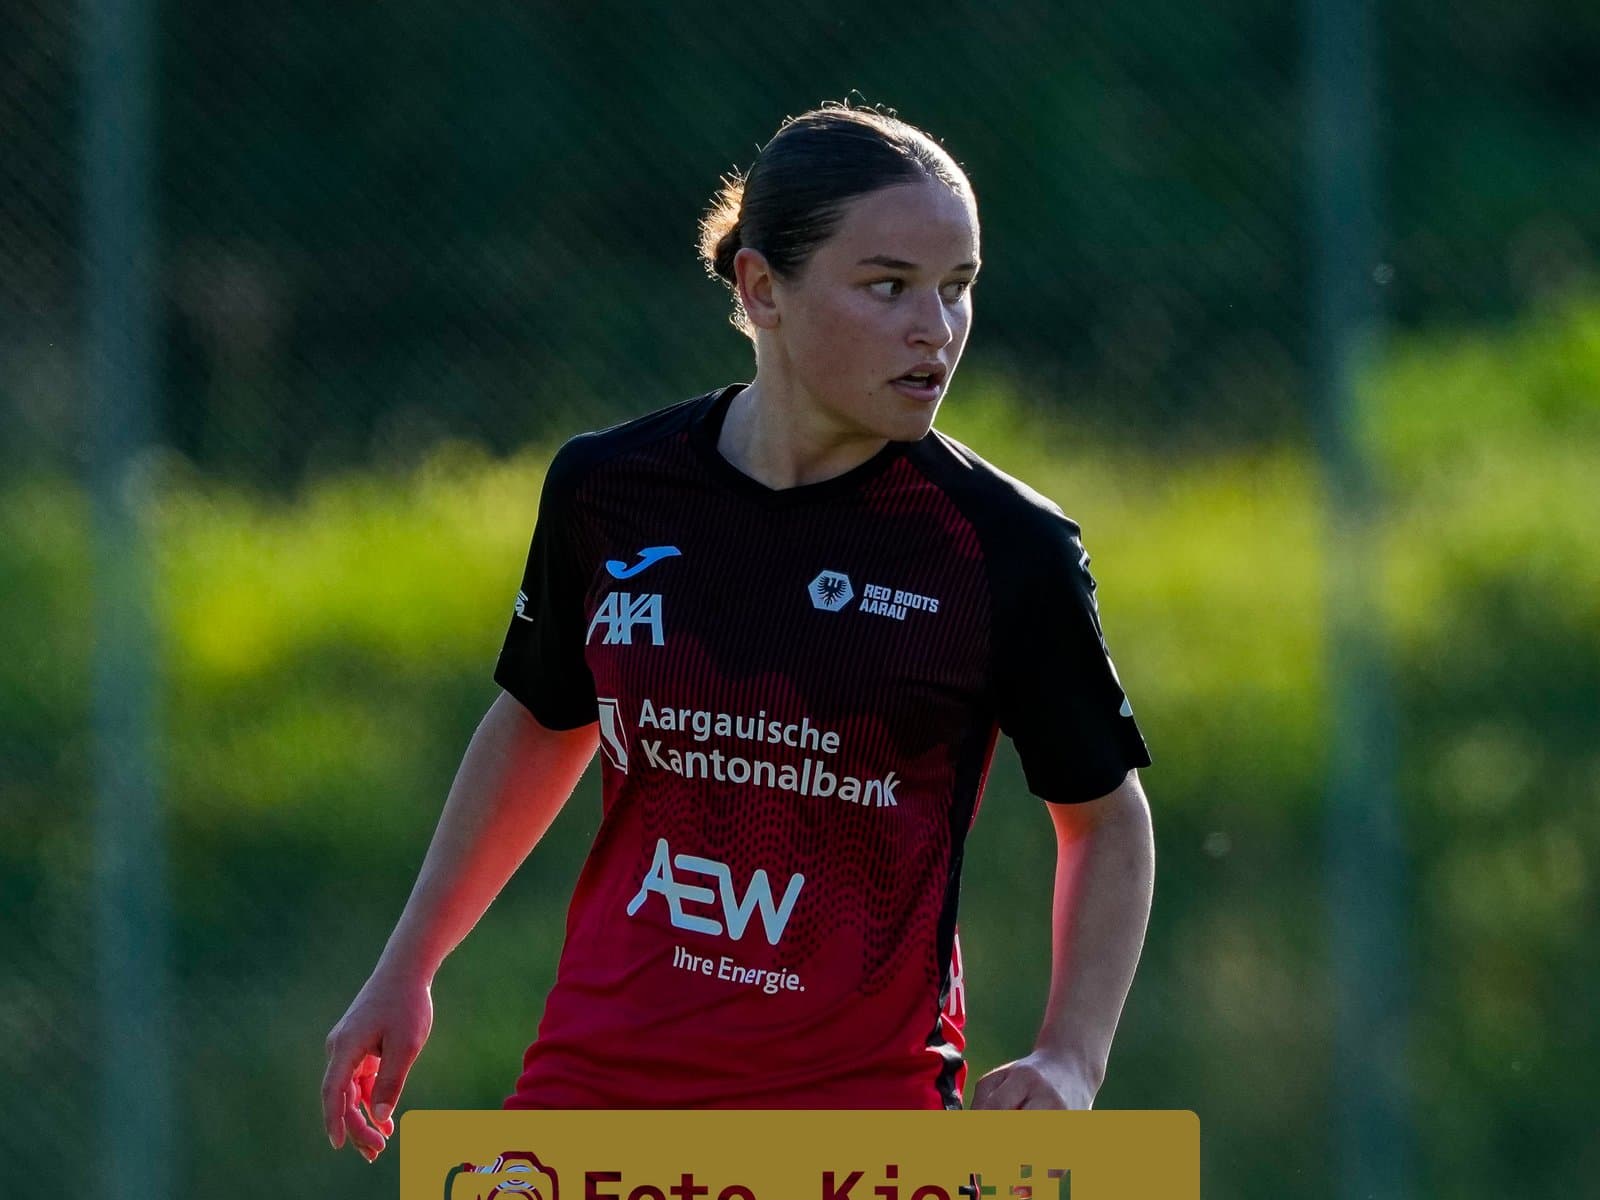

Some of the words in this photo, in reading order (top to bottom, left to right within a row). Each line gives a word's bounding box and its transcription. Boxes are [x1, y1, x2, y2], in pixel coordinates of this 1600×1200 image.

[585, 591, 665, 646] AXA
[858, 599, 907, 621] AARAU
[863, 583, 891, 602] RED
[893, 589, 939, 614] BOOTS
[638, 698, 840, 754] Aargauische
[640, 739, 901, 808] Kantonalbank
[626, 837, 806, 946] AEW
[672, 945, 714, 976] Ihre
[717, 956, 806, 995] Energie.
